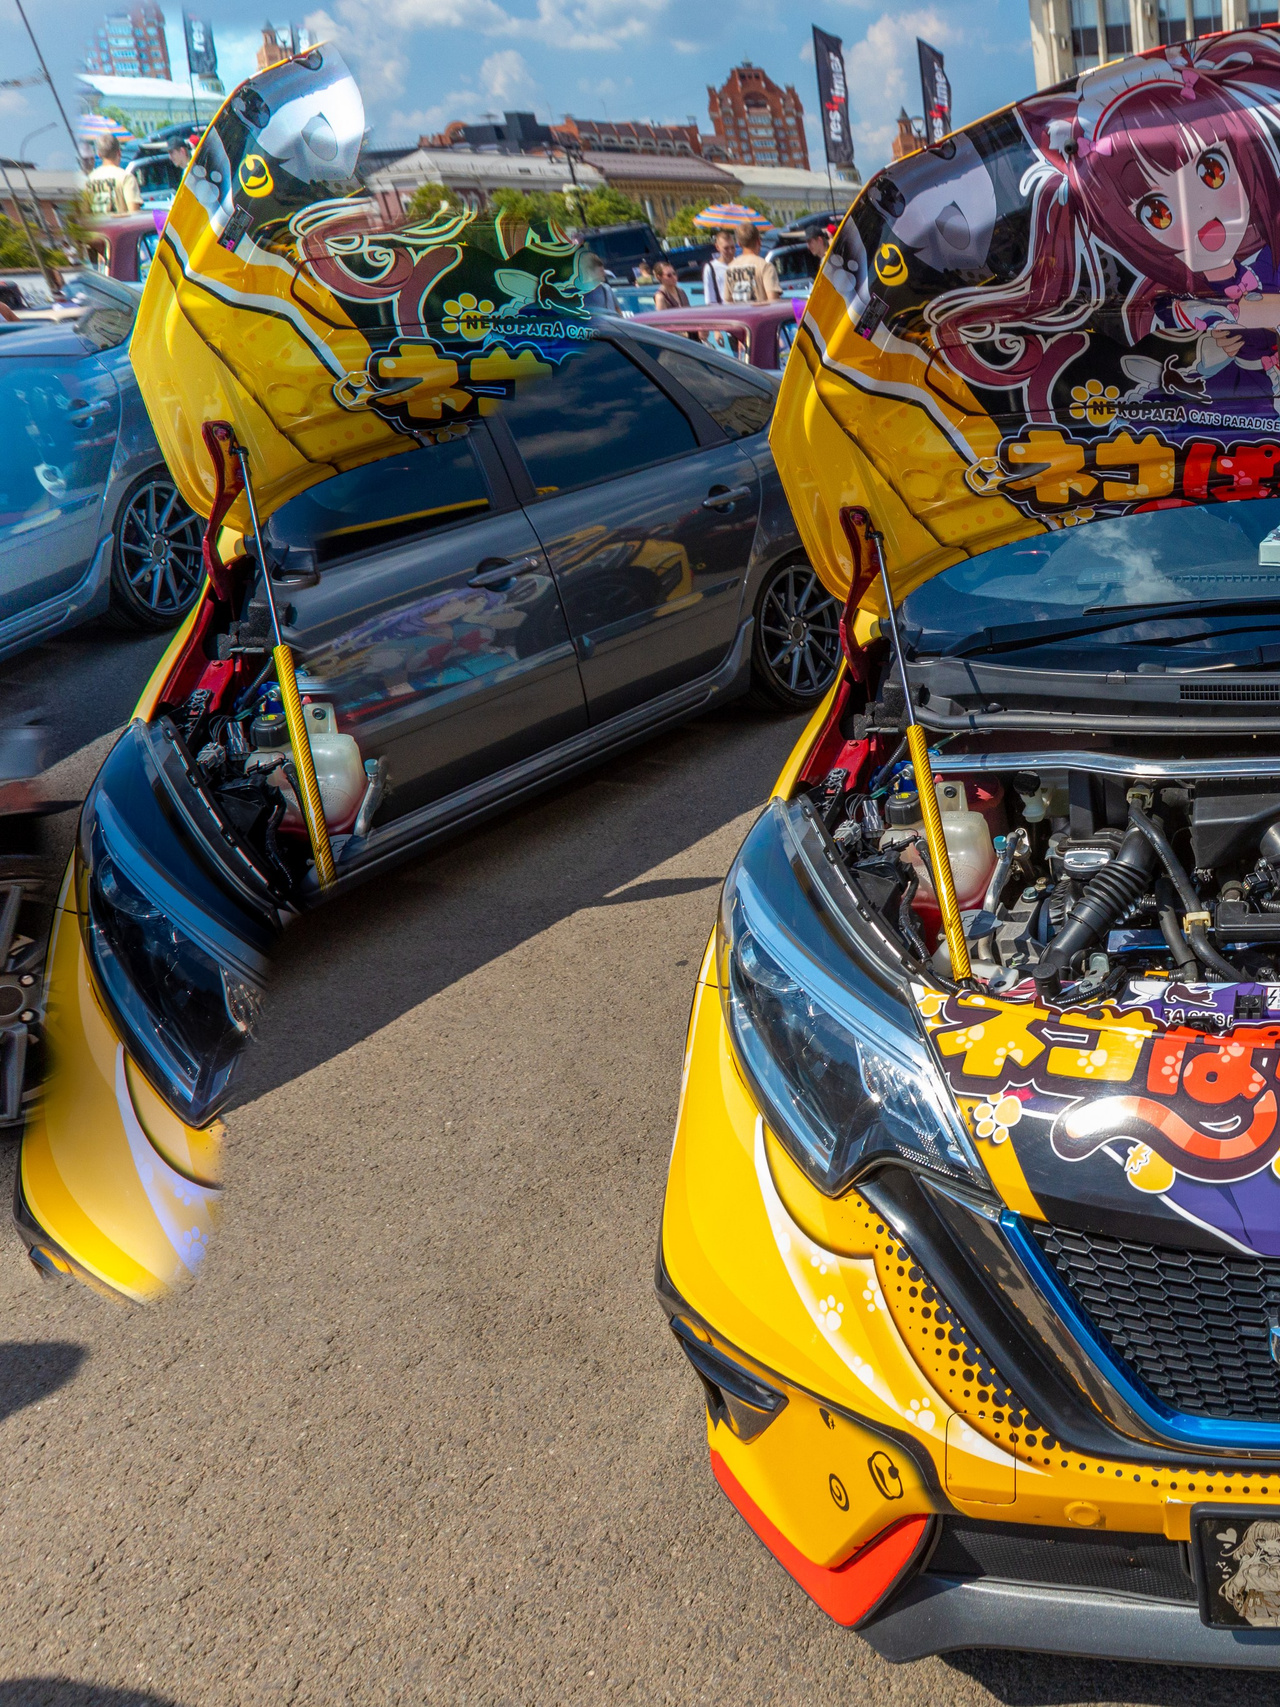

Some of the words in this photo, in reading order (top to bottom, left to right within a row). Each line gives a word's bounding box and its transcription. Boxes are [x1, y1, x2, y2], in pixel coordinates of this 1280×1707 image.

[1092, 400, 1186, 424] NEKOPARA
[1188, 410, 1221, 426] CATS
[1222, 416, 1280, 432] PARADISE
